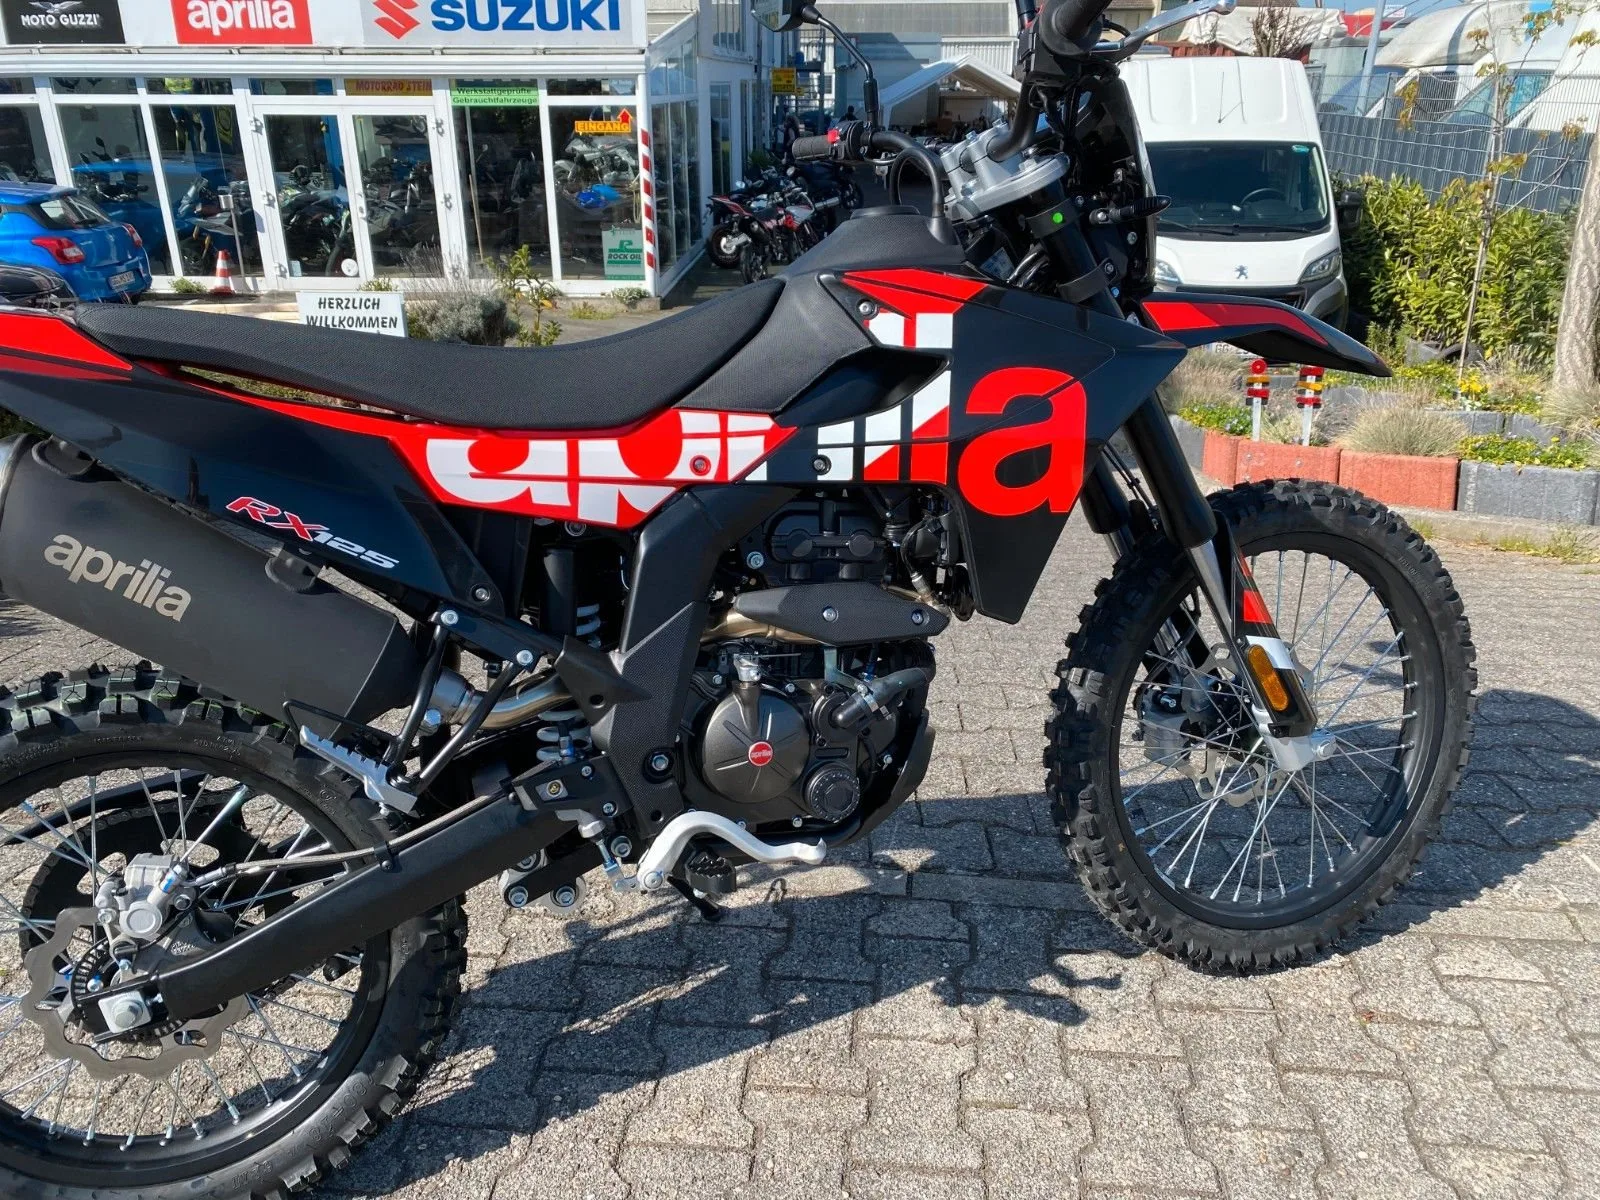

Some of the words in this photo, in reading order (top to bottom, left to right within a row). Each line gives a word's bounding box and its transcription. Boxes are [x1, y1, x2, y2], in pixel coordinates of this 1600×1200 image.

[21, 14, 56, 26] MOTO
[60, 13, 97, 26] GUZZI
[187, 0, 296, 36] aprilia
[431, 0, 620, 31] SUZUKI
[356, 80, 403, 92] MOTORRAD
[407, 80, 432, 92] STEIN
[456, 87, 532, 97] Werkstattgeprüfte
[452, 96, 538, 105] Gebrauchtfahrzeuge
[577, 122, 629, 131] EINGANG
[318, 297, 380, 310] HERZLICH
[306, 315, 398, 329] WILLKOMMEN
[44, 534, 192, 622] aprilia
